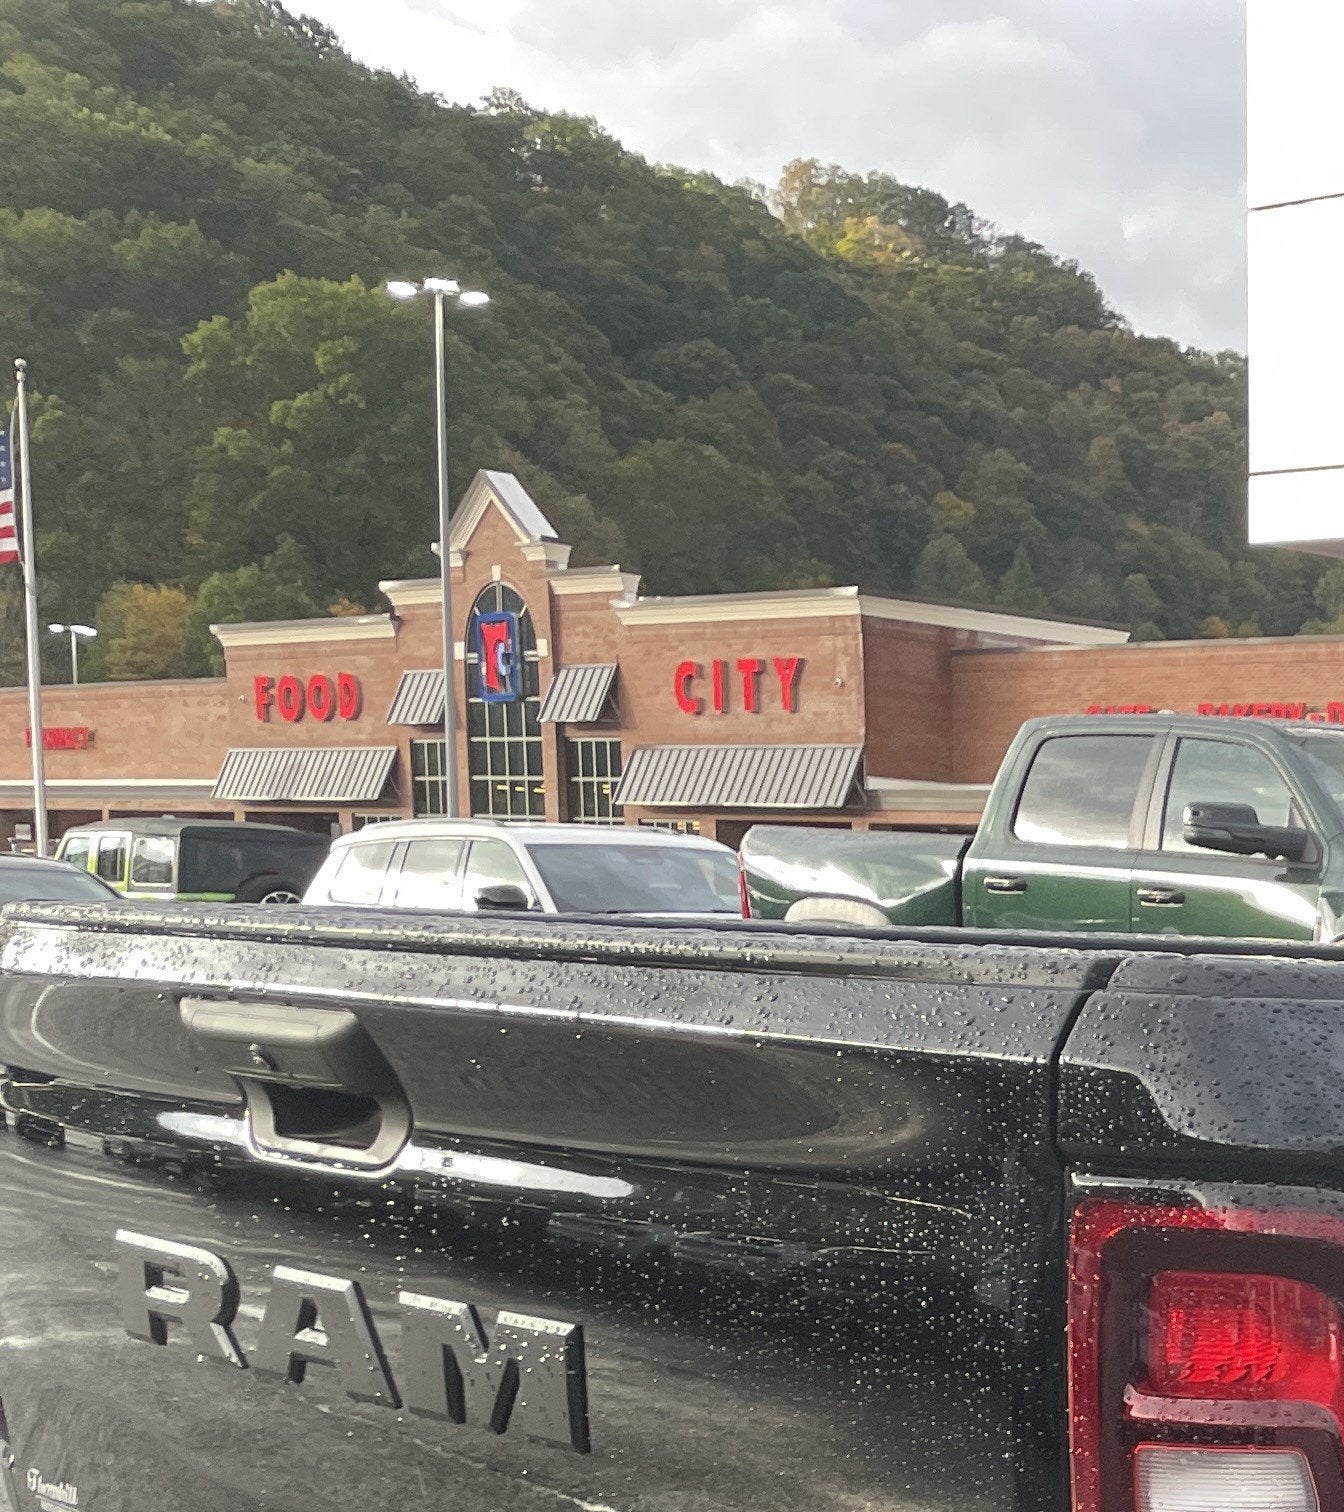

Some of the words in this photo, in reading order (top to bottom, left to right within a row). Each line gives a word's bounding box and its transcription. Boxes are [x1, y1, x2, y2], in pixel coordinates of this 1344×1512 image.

[254, 671, 361, 721] FOOD
[674, 655, 805, 715] CITY
[114, 1228, 593, 1453] RAM
